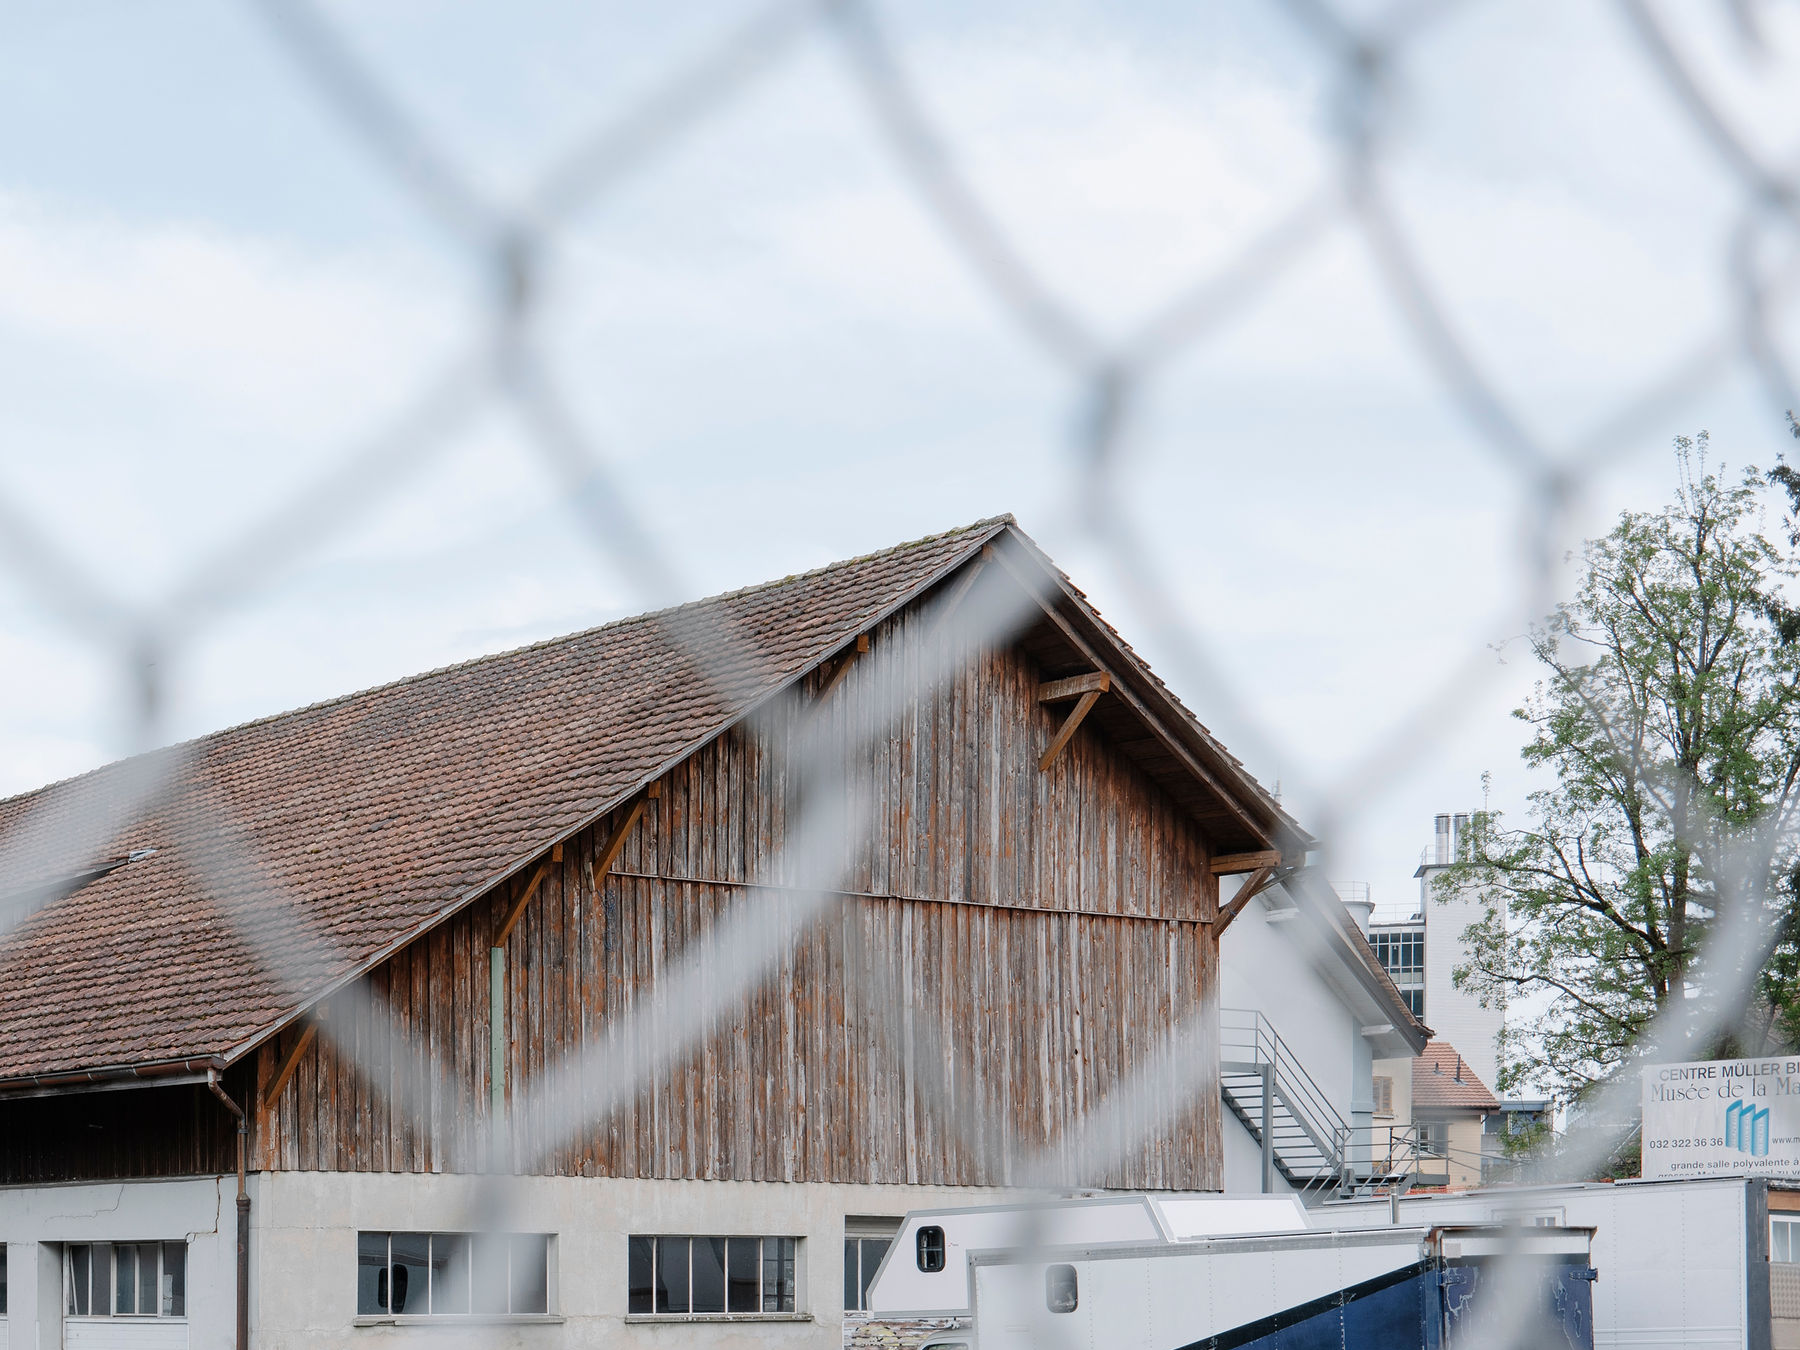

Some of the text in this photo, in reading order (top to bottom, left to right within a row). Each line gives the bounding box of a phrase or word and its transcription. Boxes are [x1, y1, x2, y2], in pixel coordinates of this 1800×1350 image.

[1660, 1066, 1717, 1081] CENTRE
[1722, 1062, 1781, 1078] MÜLLER
[1651, 1083, 1710, 1102] Musée
[1717, 1079, 1745, 1099] de
[1752, 1077, 1767, 1097] la
[1649, 1140, 1669, 1149] 032
[1671, 1139, 1691, 1148] 322
[1694, 1138, 1707, 1147] 36
[1710, 1137, 1724, 1147] 36
[1671, 1160, 1704, 1171] grande
[1707, 1159, 1730, 1169] salle
[1733, 1157, 1790, 1169] polyvalente
